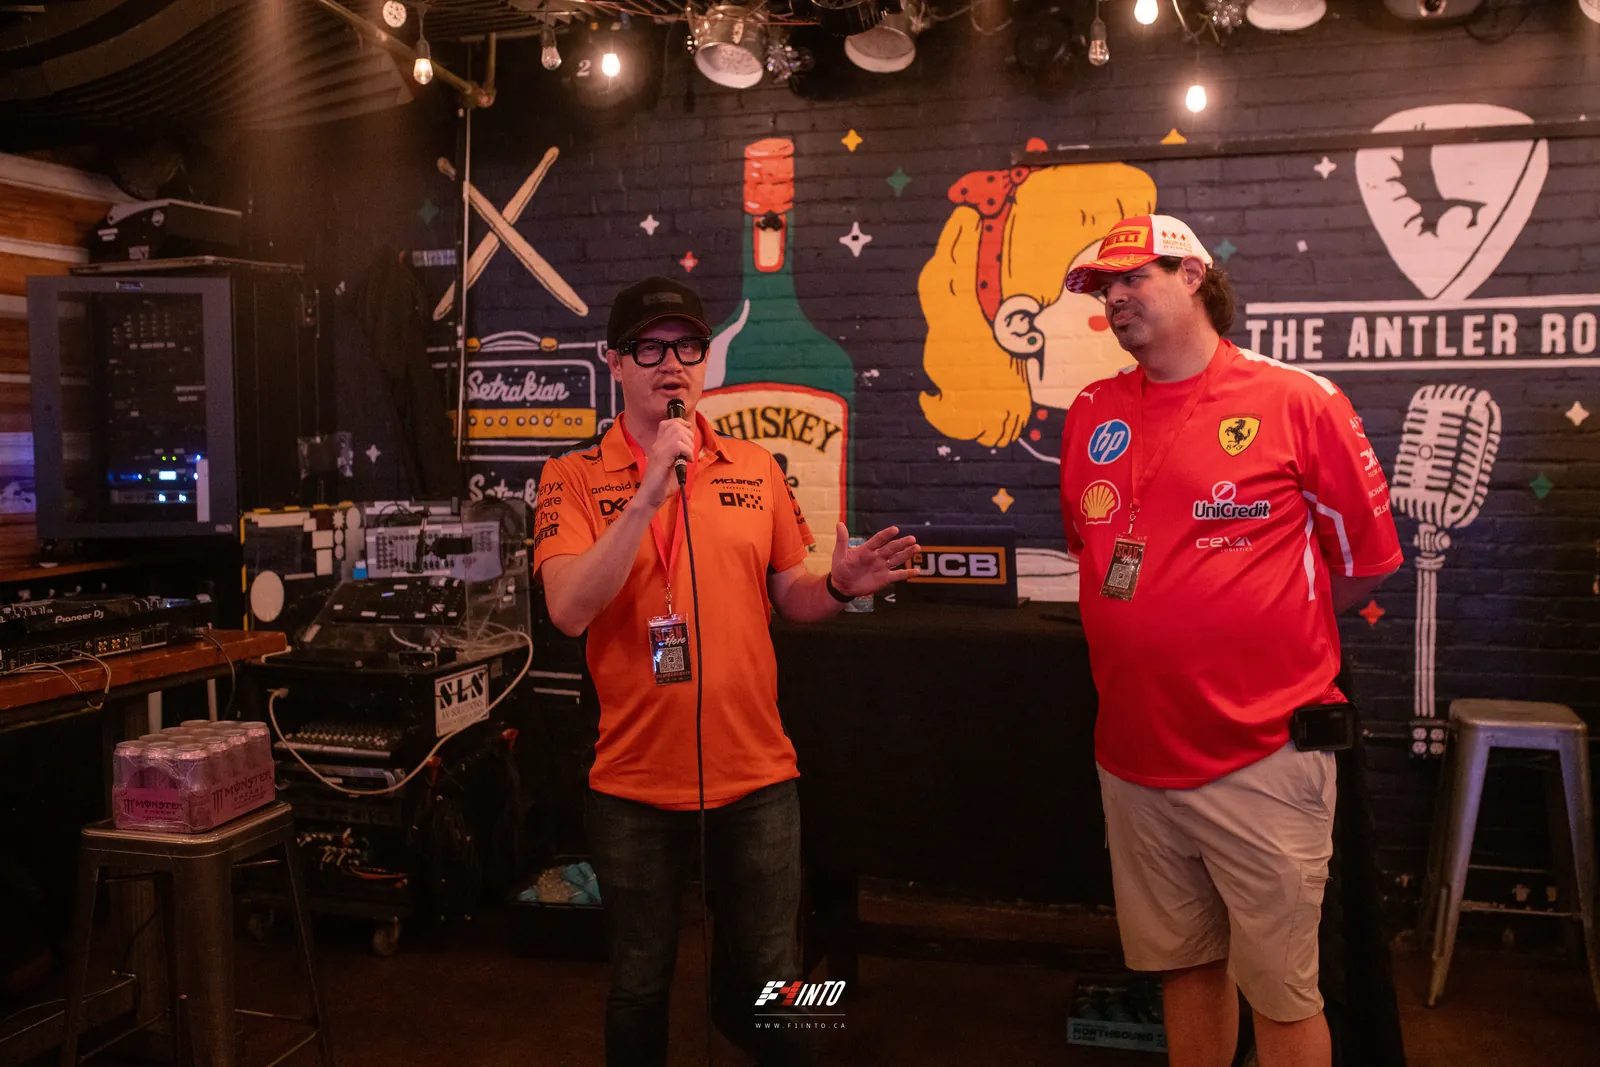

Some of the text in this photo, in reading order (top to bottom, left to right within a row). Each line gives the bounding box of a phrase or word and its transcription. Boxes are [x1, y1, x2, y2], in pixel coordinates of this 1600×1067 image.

[576, 59, 592, 77] 2
[1246, 312, 1598, 362] THE ANTLER RO
[467, 369, 570, 403] Setrakian
[1092, 419, 1126, 464] hp
[537, 481, 564, 499] eryx
[591, 480, 632, 495] android
[709, 478, 763, 488] McLaren
[536, 495, 562, 512] ware
[1194, 501, 1270, 519] UniCredit
[1116, 545, 1140, 559] SCAN
[913, 553, 999, 577] JCB
[55, 612, 93, 624] Pioneer
[665, 635, 687, 647] Here
[439, 672, 484, 709] SLS
[135, 799, 183, 810] MONSTER
[1073, 1026, 1154, 1042] NORTHBOUND
